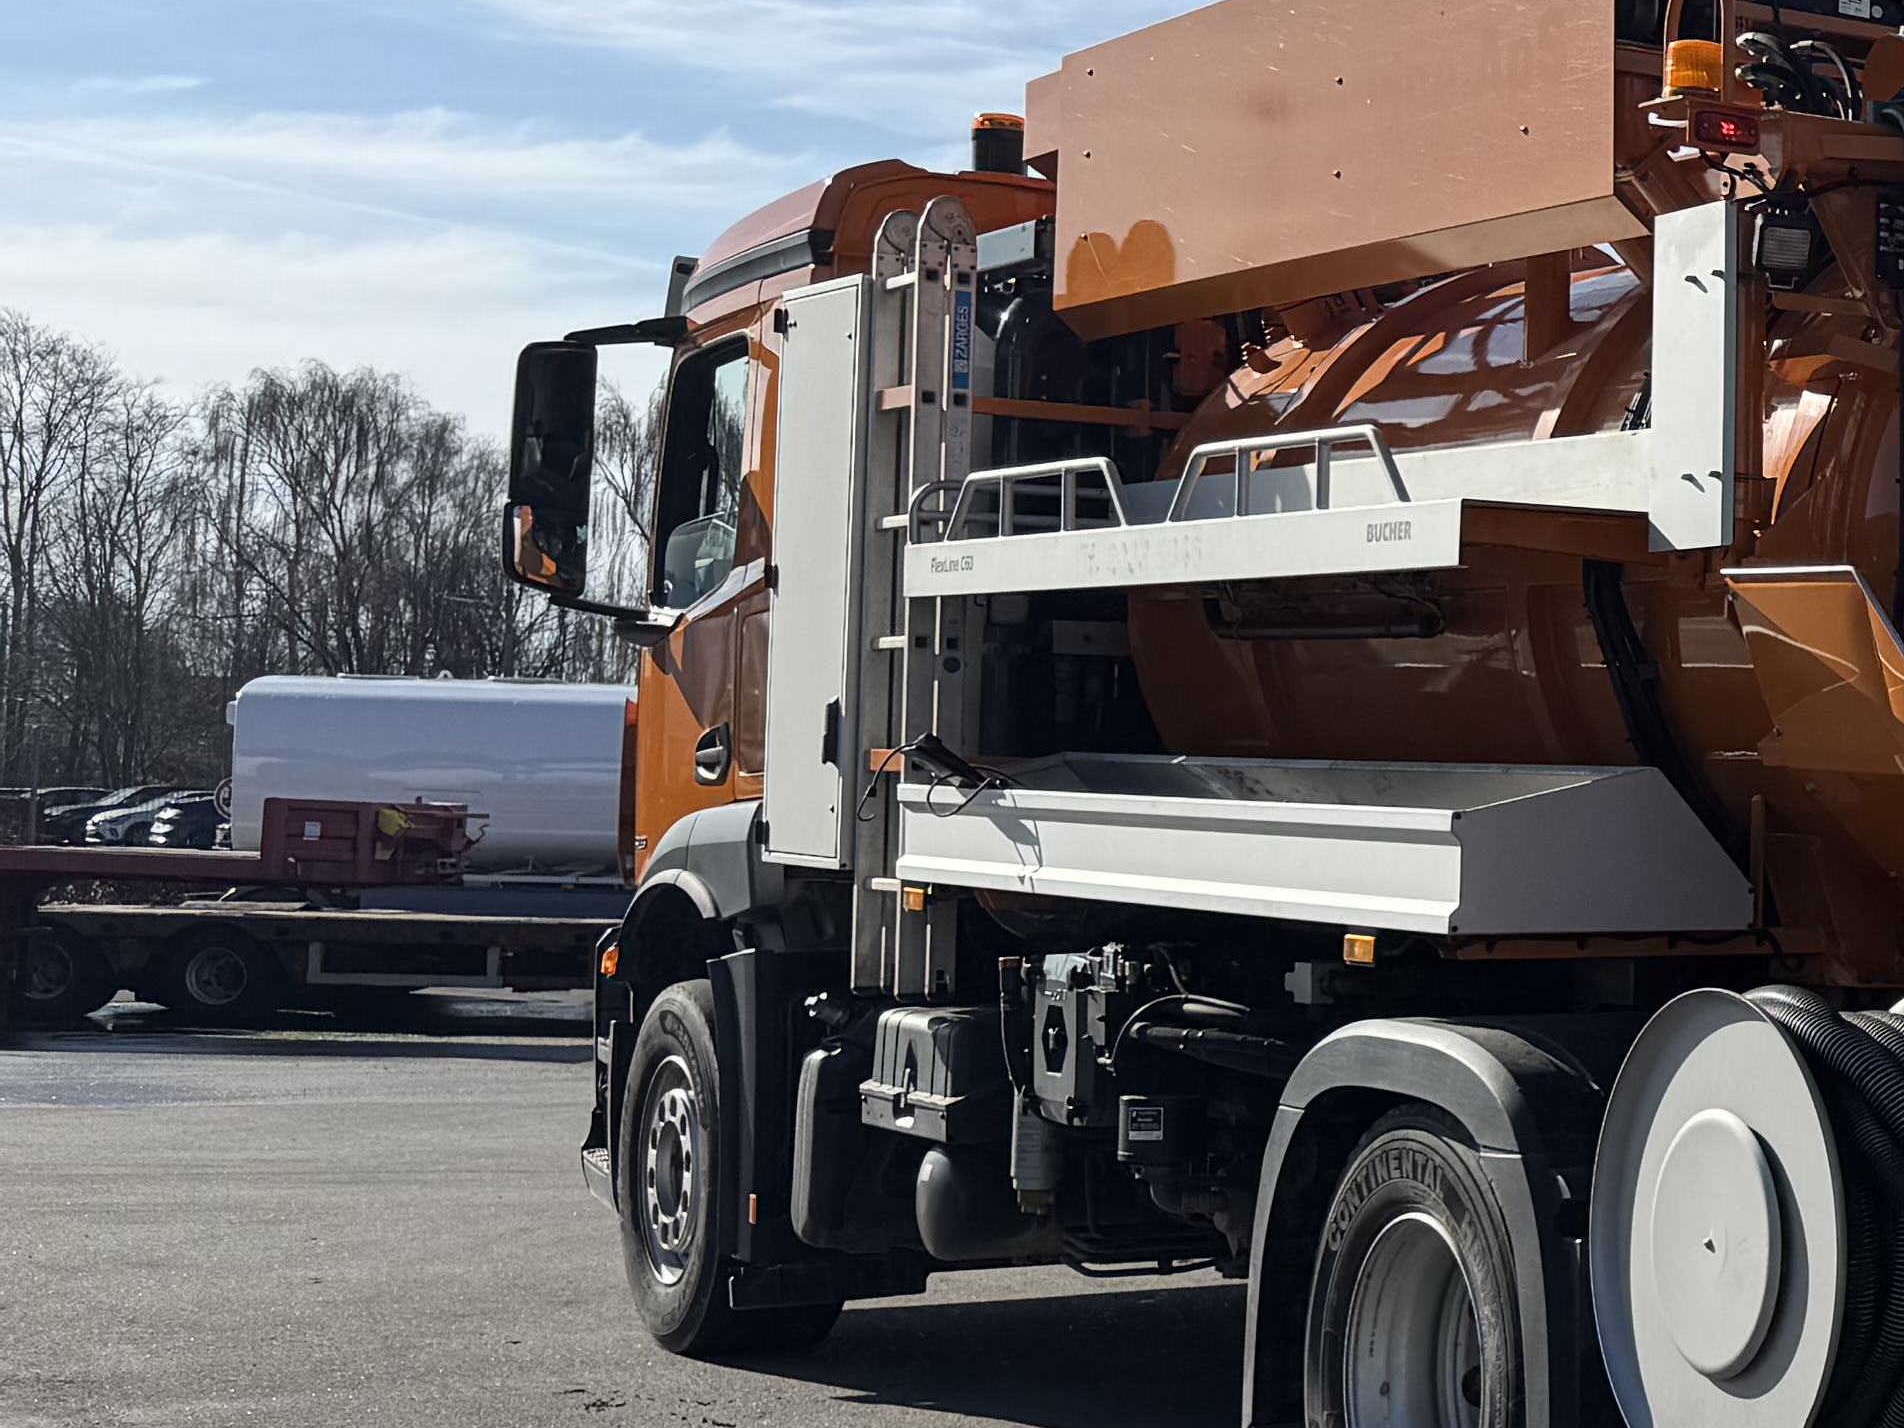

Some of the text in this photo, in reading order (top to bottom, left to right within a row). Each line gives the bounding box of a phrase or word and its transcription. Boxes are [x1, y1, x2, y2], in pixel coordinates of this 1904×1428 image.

[955, 305, 969, 359] ZARGES
[1366, 521, 1411, 543] BUCHER
[1328, 1147, 1444, 1252] CONTINENTAL
